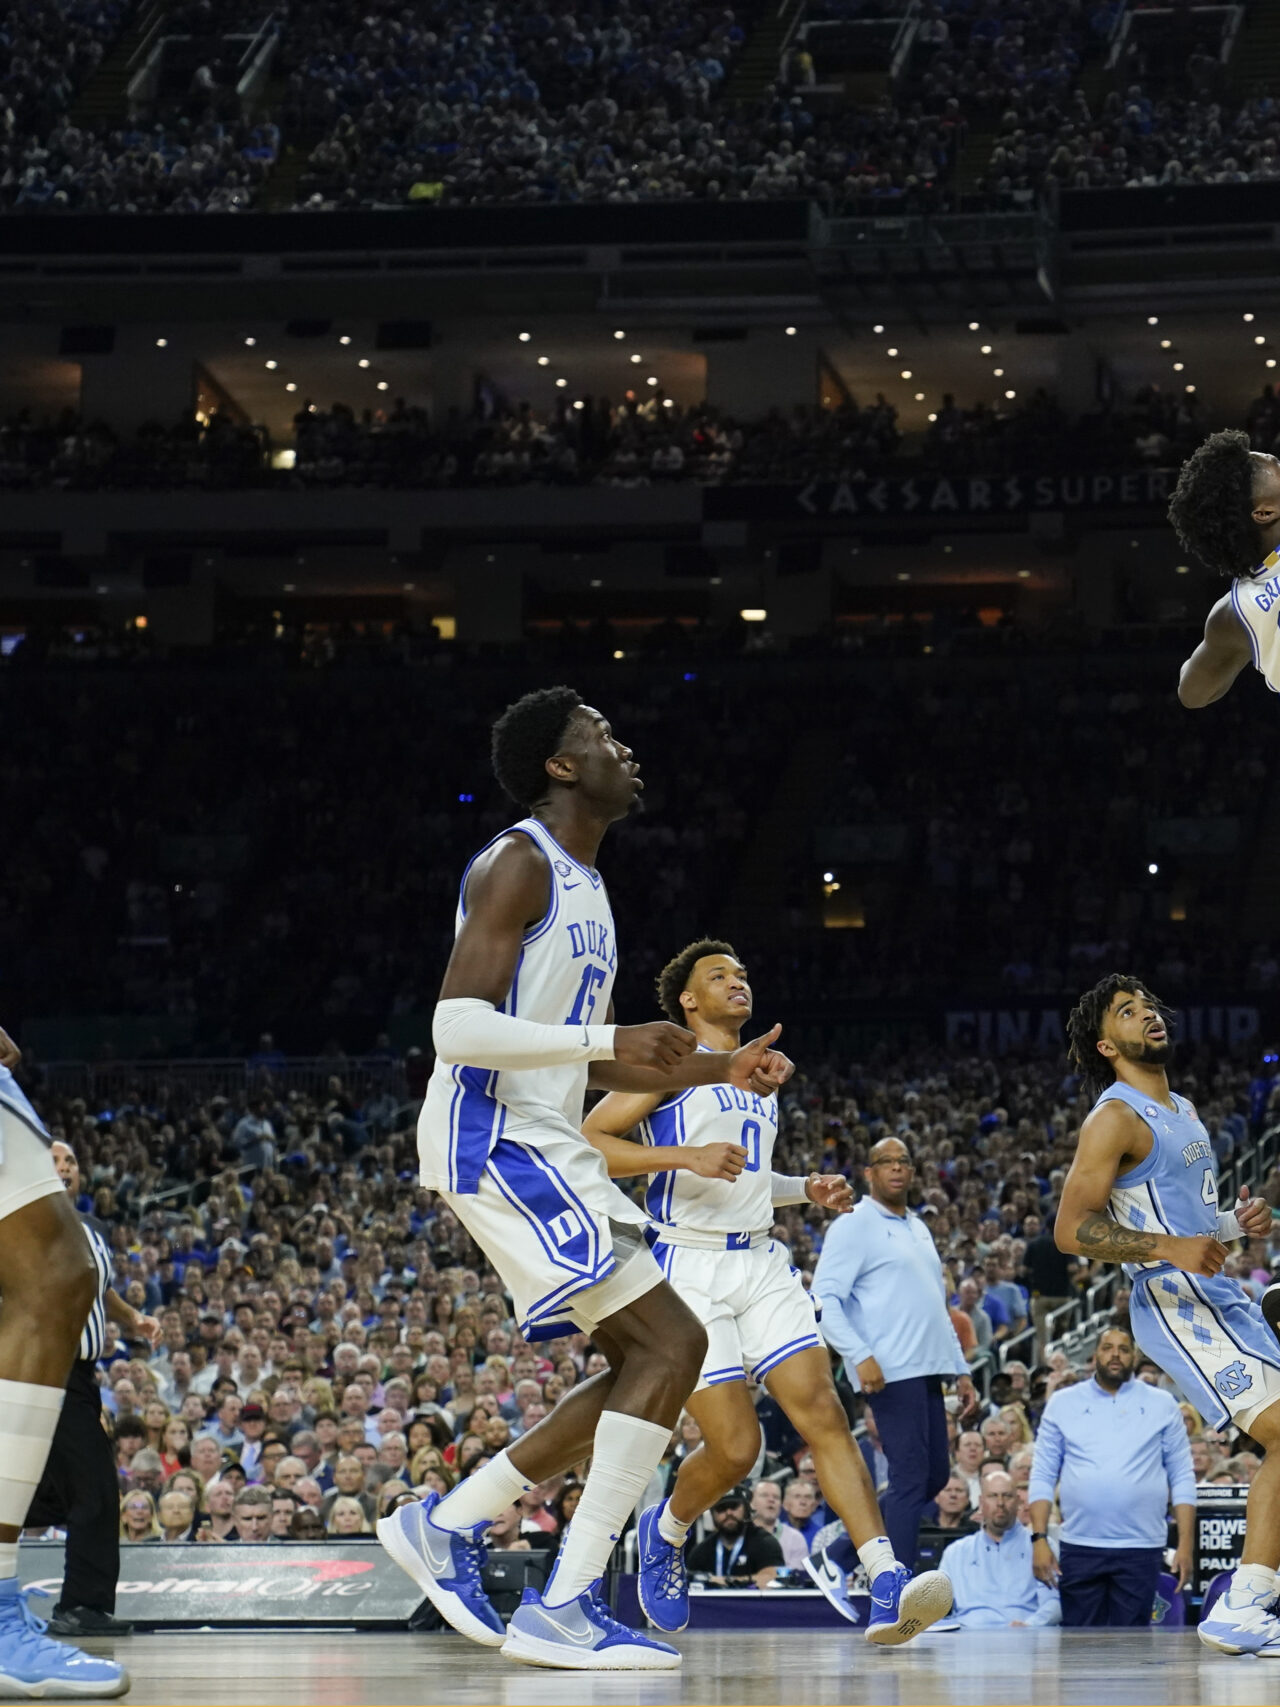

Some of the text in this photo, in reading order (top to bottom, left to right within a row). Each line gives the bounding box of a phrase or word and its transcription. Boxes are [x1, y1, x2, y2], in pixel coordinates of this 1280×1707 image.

[797, 474, 1169, 512] CAESARS SUPER
[565, 963, 607, 1026] 15
[945, 1008, 1065, 1052] FINA
[711, 1084, 778, 1128] DUKE
[741, 1119, 760, 1173] 0
[1201, 1168, 1219, 1219] 4
[1200, 1519, 1247, 1535] POWE
[1200, 1534, 1233, 1550] ADE
[1200, 1557, 1241, 1570] PAU
